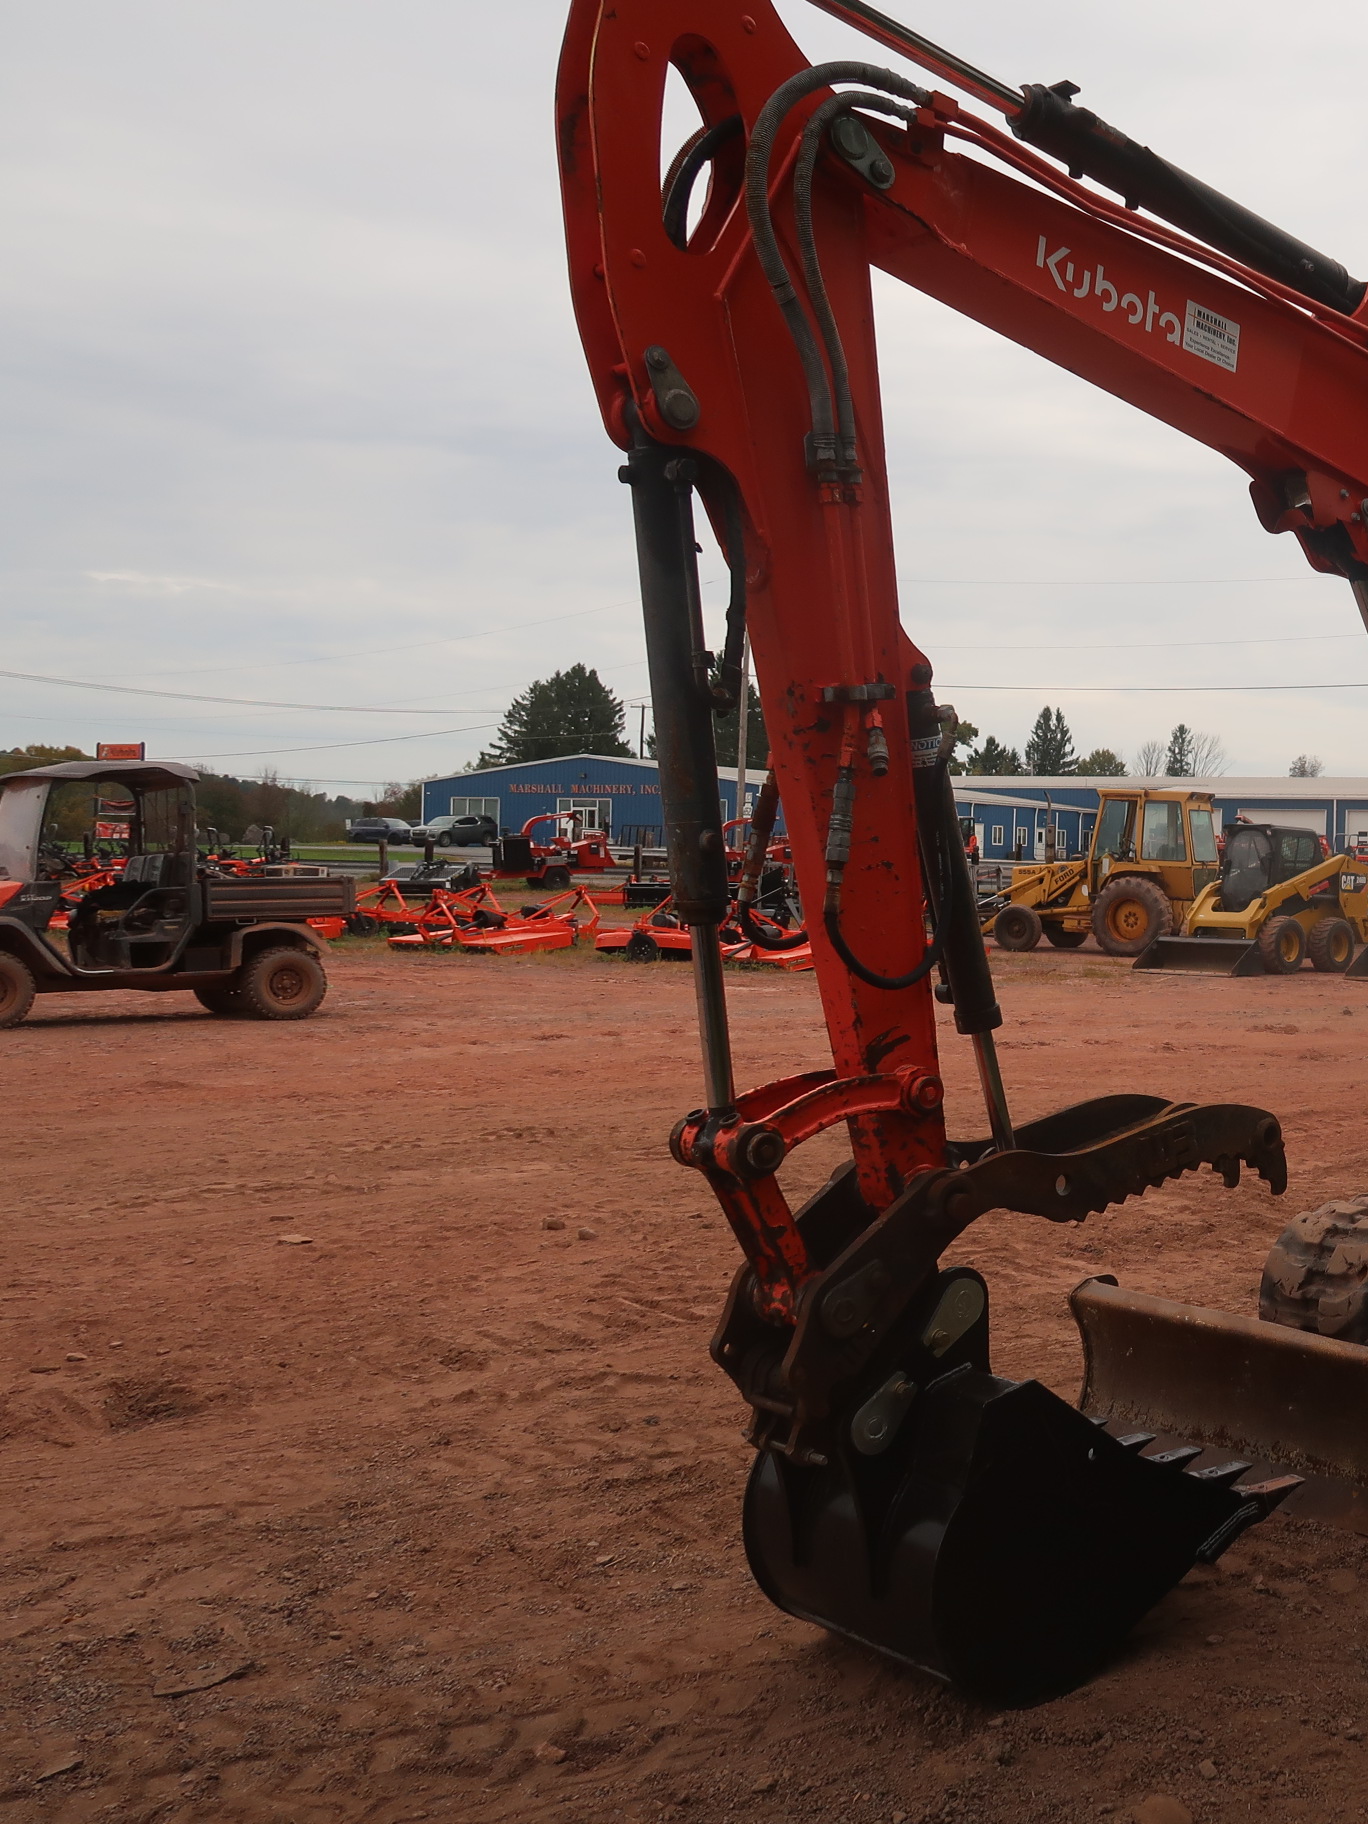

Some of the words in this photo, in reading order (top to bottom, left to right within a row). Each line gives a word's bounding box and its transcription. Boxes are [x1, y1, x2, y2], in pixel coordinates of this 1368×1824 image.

[1036, 235, 1181, 346] Kubota
[1197, 309, 1227, 331] MARSHALL
[1186, 327, 1199, 337] SALES
[1220, 343, 1236, 355] SERVICE
[1189, 337, 1210, 351] Experience
[1194, 345, 1204, 354] Local
[1204, 350, 1216, 360] Dealer
[1221, 358, 1234, 369] Choice
[911, 738, 941, 750] NOTIC
[508, 784, 564, 794] MARSHALL
[571, 784, 637, 795] MACHINERY,
[640, 784, 661, 794] INC.
[1054, 868, 1075, 885] FORD
[1341, 875, 1355, 890] CAT
